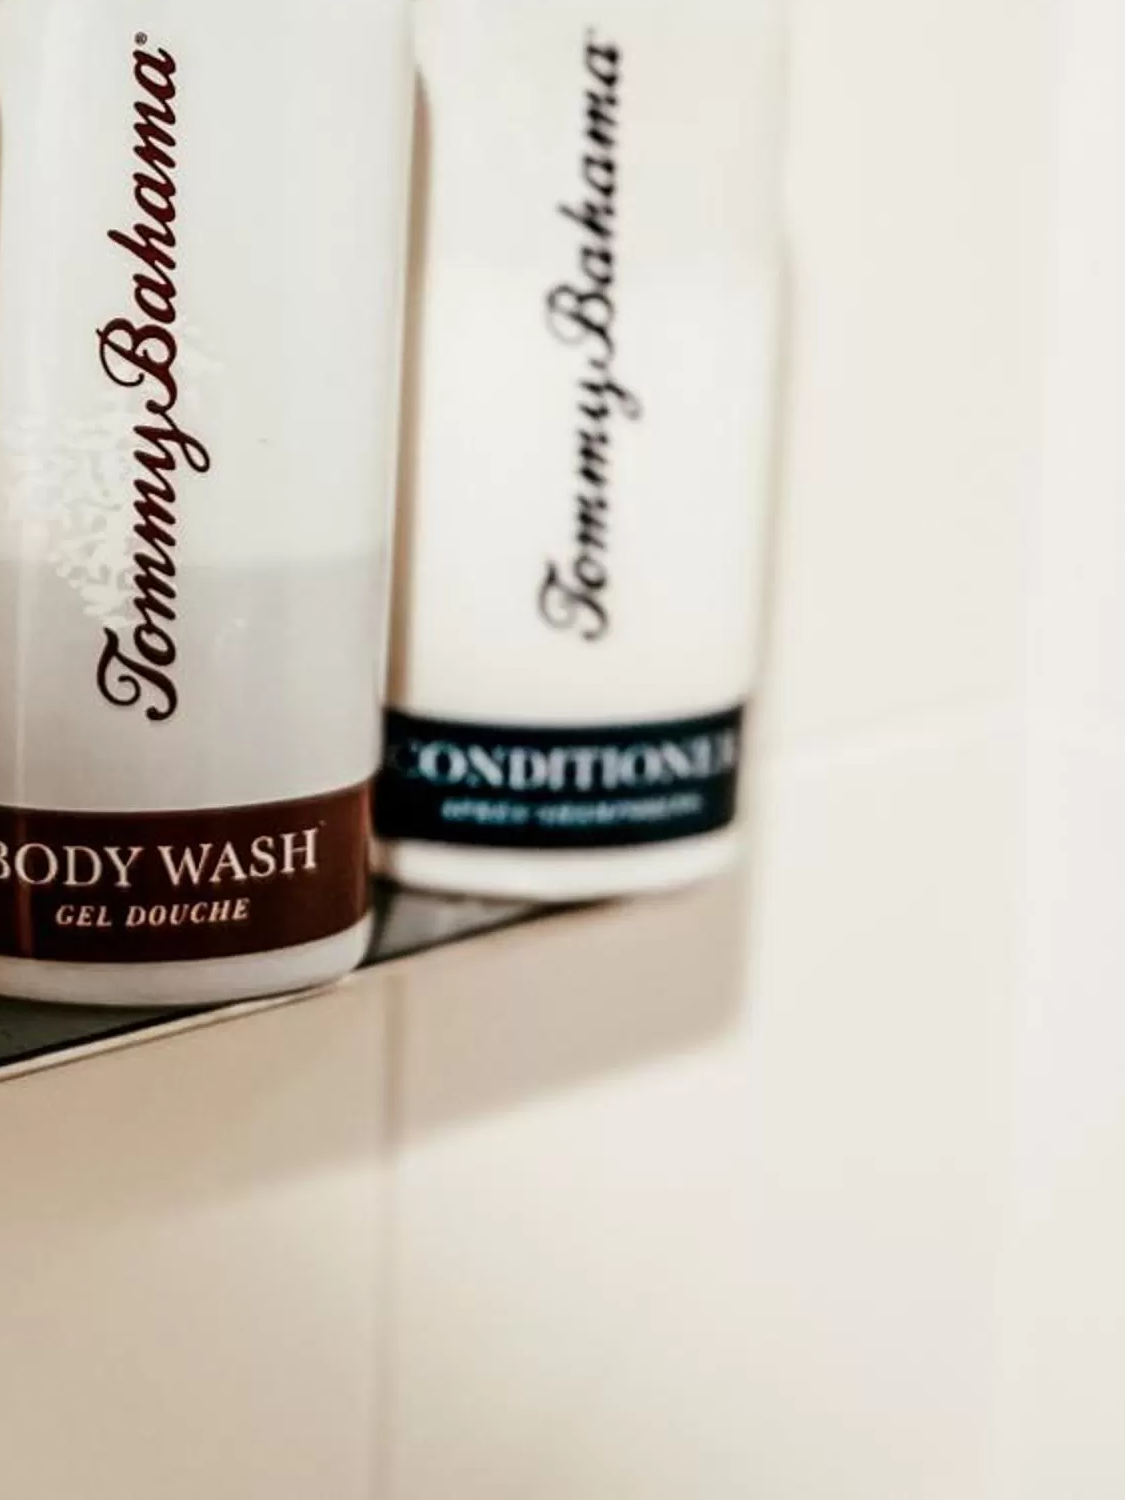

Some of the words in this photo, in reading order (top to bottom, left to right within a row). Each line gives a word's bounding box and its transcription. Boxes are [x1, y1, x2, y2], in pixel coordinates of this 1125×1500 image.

[96, 411, 211, 721] Tommy
[536, 367, 643, 644] Tommy
[55, 904, 113, 927] GEL
[125, 897, 251, 928] DOUCHE
[156, 826, 320, 886] WASH
